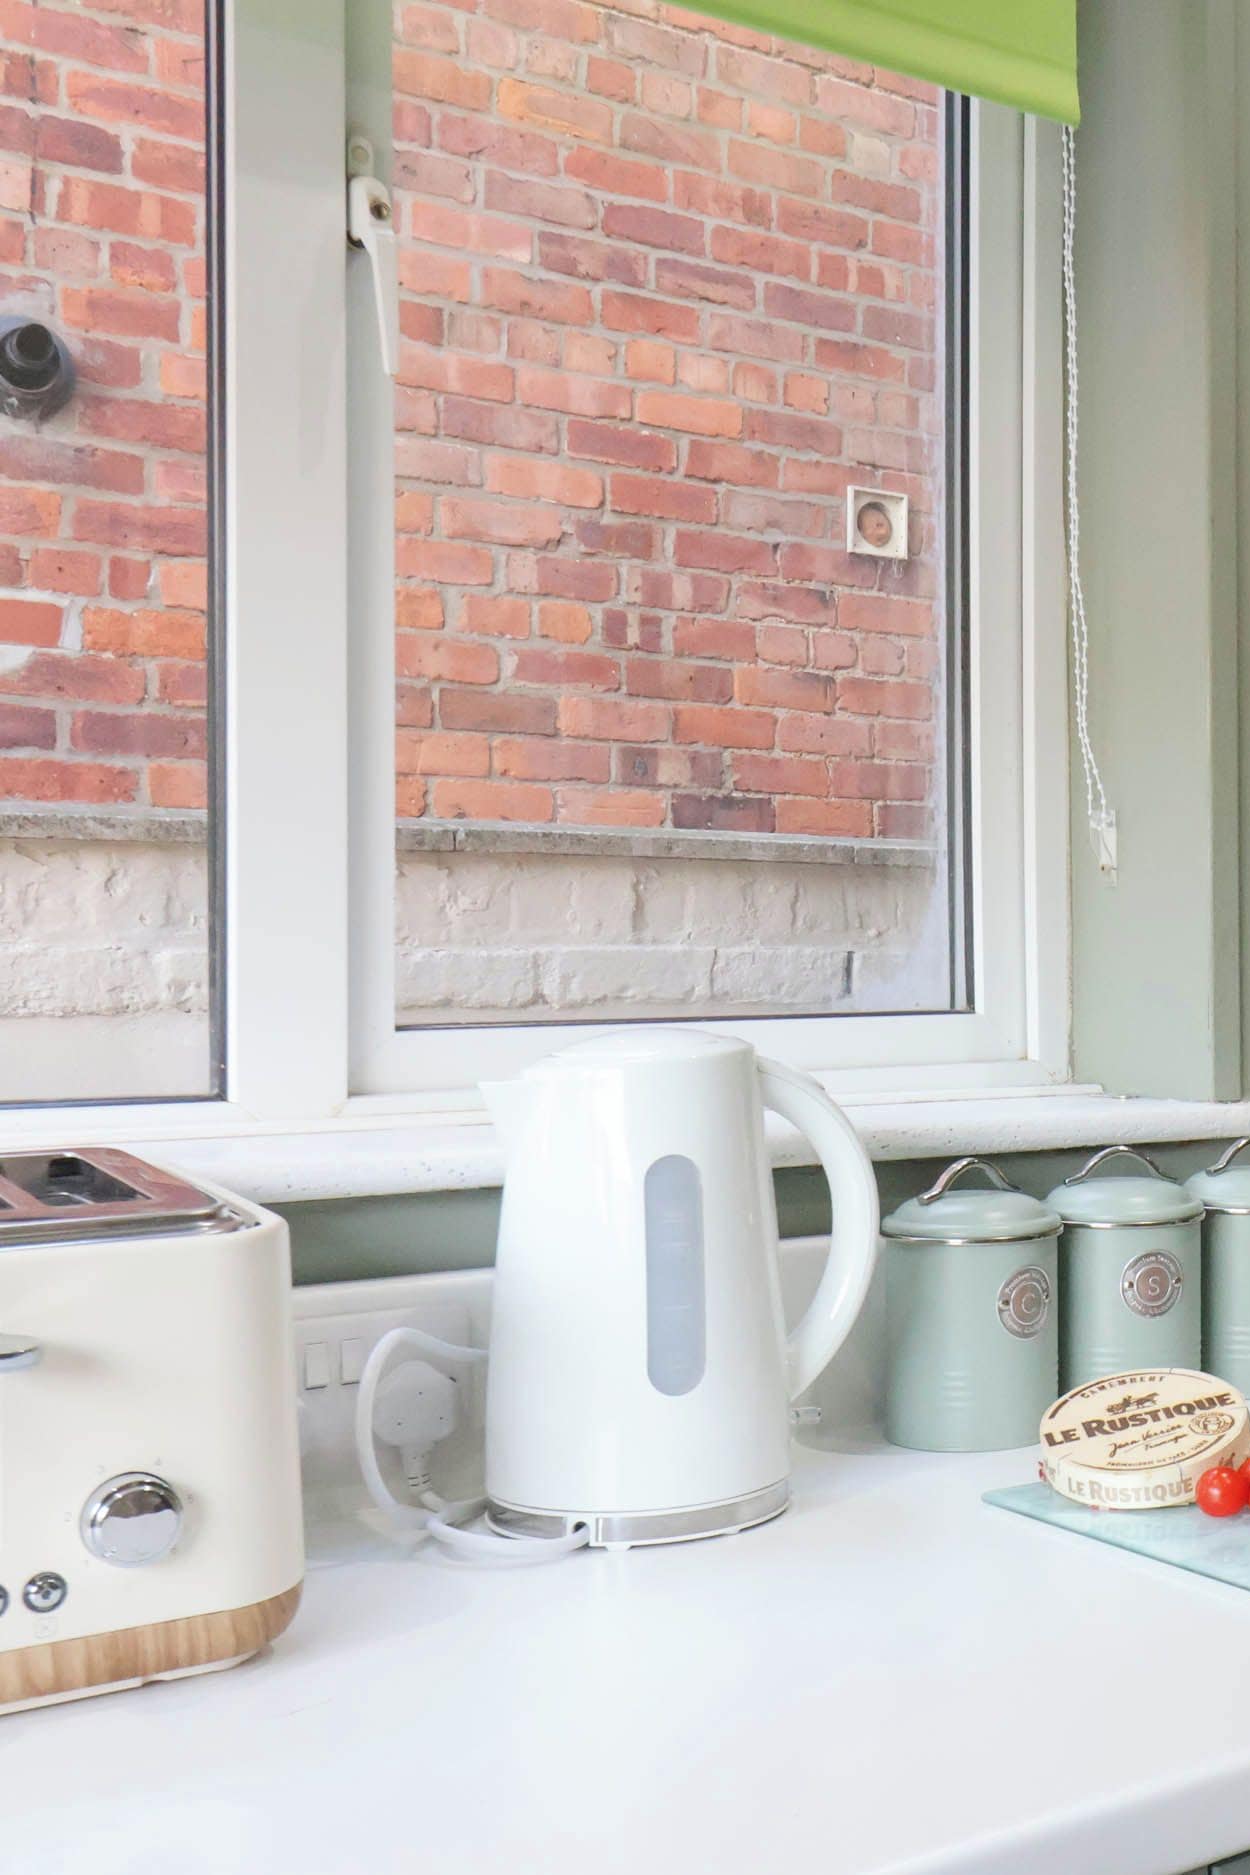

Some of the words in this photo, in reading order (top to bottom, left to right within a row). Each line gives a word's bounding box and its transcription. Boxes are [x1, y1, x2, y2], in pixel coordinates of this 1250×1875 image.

[1148, 1275, 1160, 1297] S
[1021, 1292, 1036, 1314] C
[1080, 1375, 1166, 1399] CAMEMBERT
[1044, 1428, 1081, 1447] LE
[1081, 1392, 1236, 1438] RUSTIQUE
[1068, 1476, 1085, 1496] LE
[1089, 1477, 1193, 1504] RUSTIQUE
